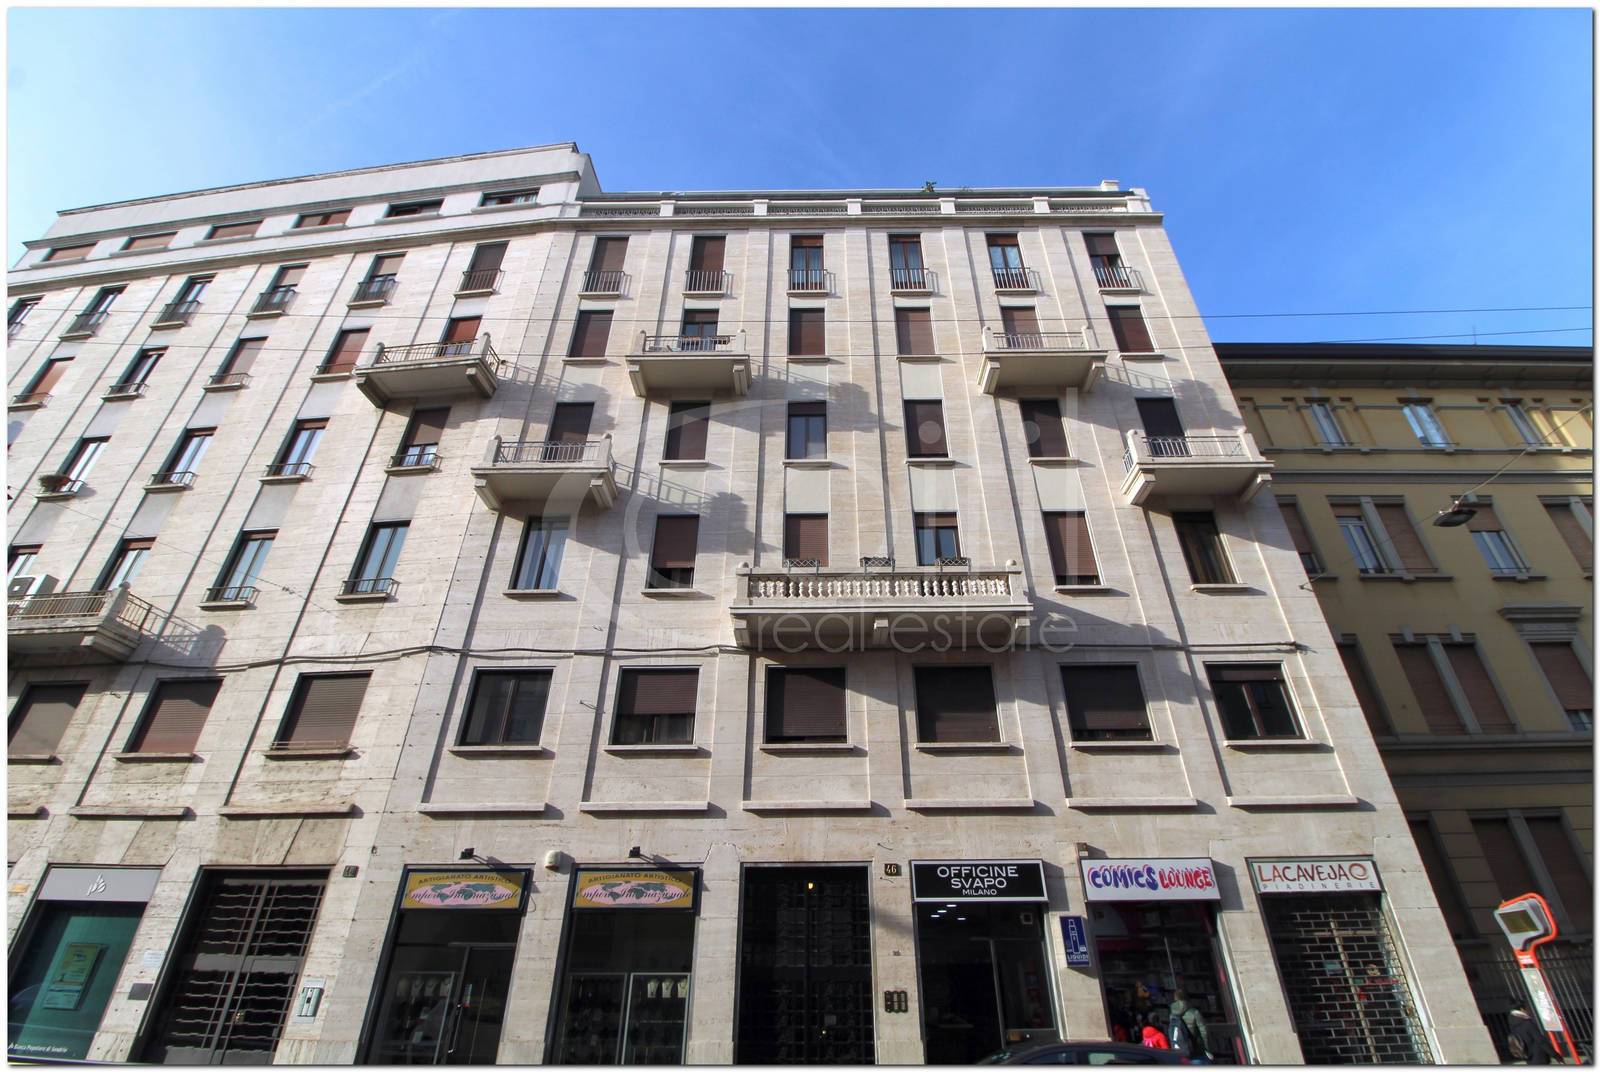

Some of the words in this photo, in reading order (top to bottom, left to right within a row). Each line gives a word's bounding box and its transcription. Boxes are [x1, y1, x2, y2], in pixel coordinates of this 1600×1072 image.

[885, 864, 897, 874] 46
[937, 866, 1018, 878] OFFICINE
[1088, 864, 1159, 891] COMICS
[1158, 866, 1215, 890] LOUNGE
[951, 878, 1007, 889] SVAPO
